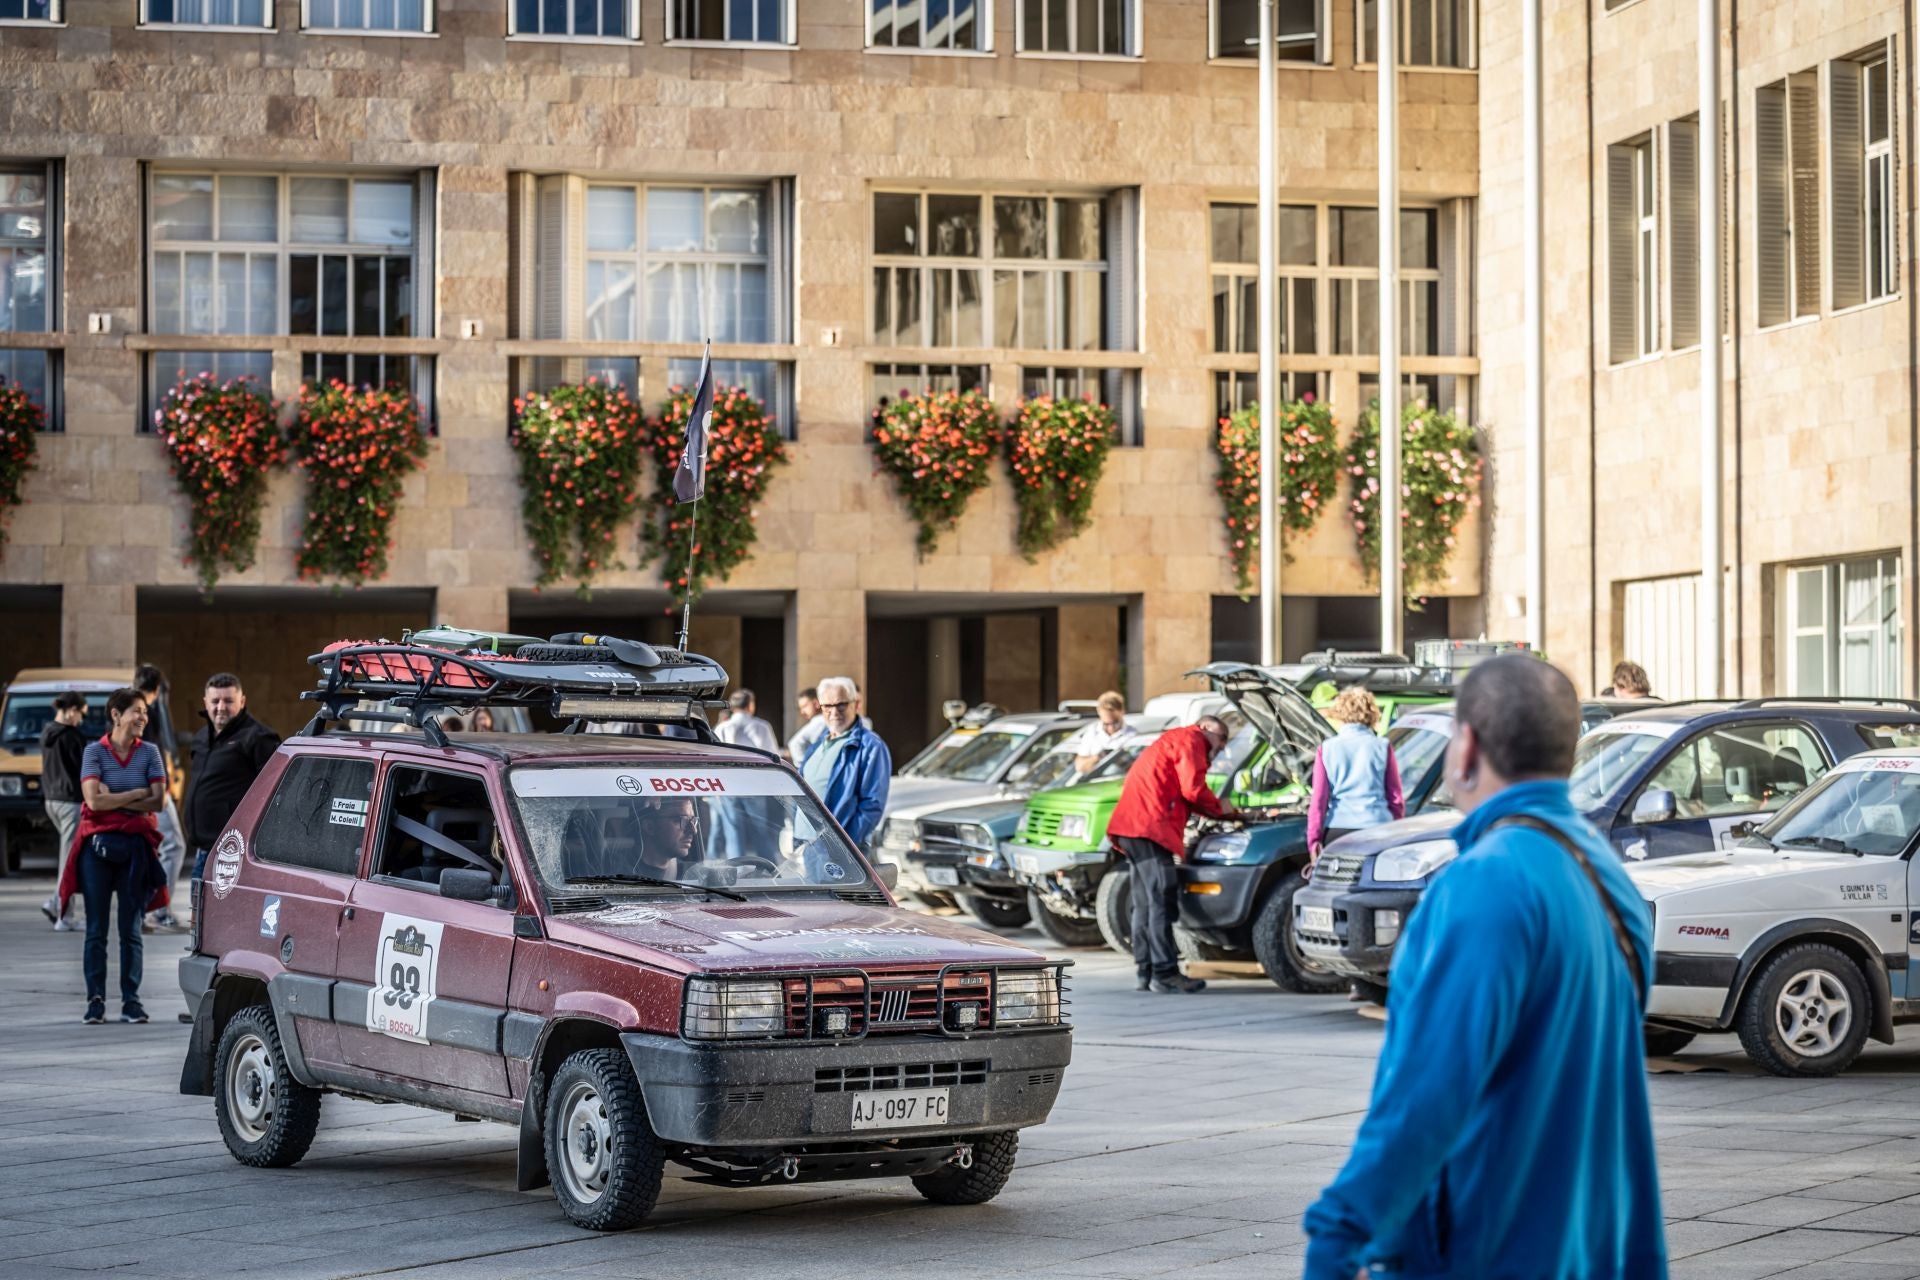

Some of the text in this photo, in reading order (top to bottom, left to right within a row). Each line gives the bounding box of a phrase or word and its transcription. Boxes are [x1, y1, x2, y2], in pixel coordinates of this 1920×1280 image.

[584, 671, 636, 679] THULE
[650, 778, 725, 792] BOSCH
[757, 927, 928, 937] PRAESIDIUM
[1678, 925, 1730, 937] FEDIMA
[383, 962, 420, 1010] 93
[960, 977, 983, 985] FIAT
[389, 1019, 414, 1036] BOSCH
[853, 1096, 946, 1122] AJ 097 FC
